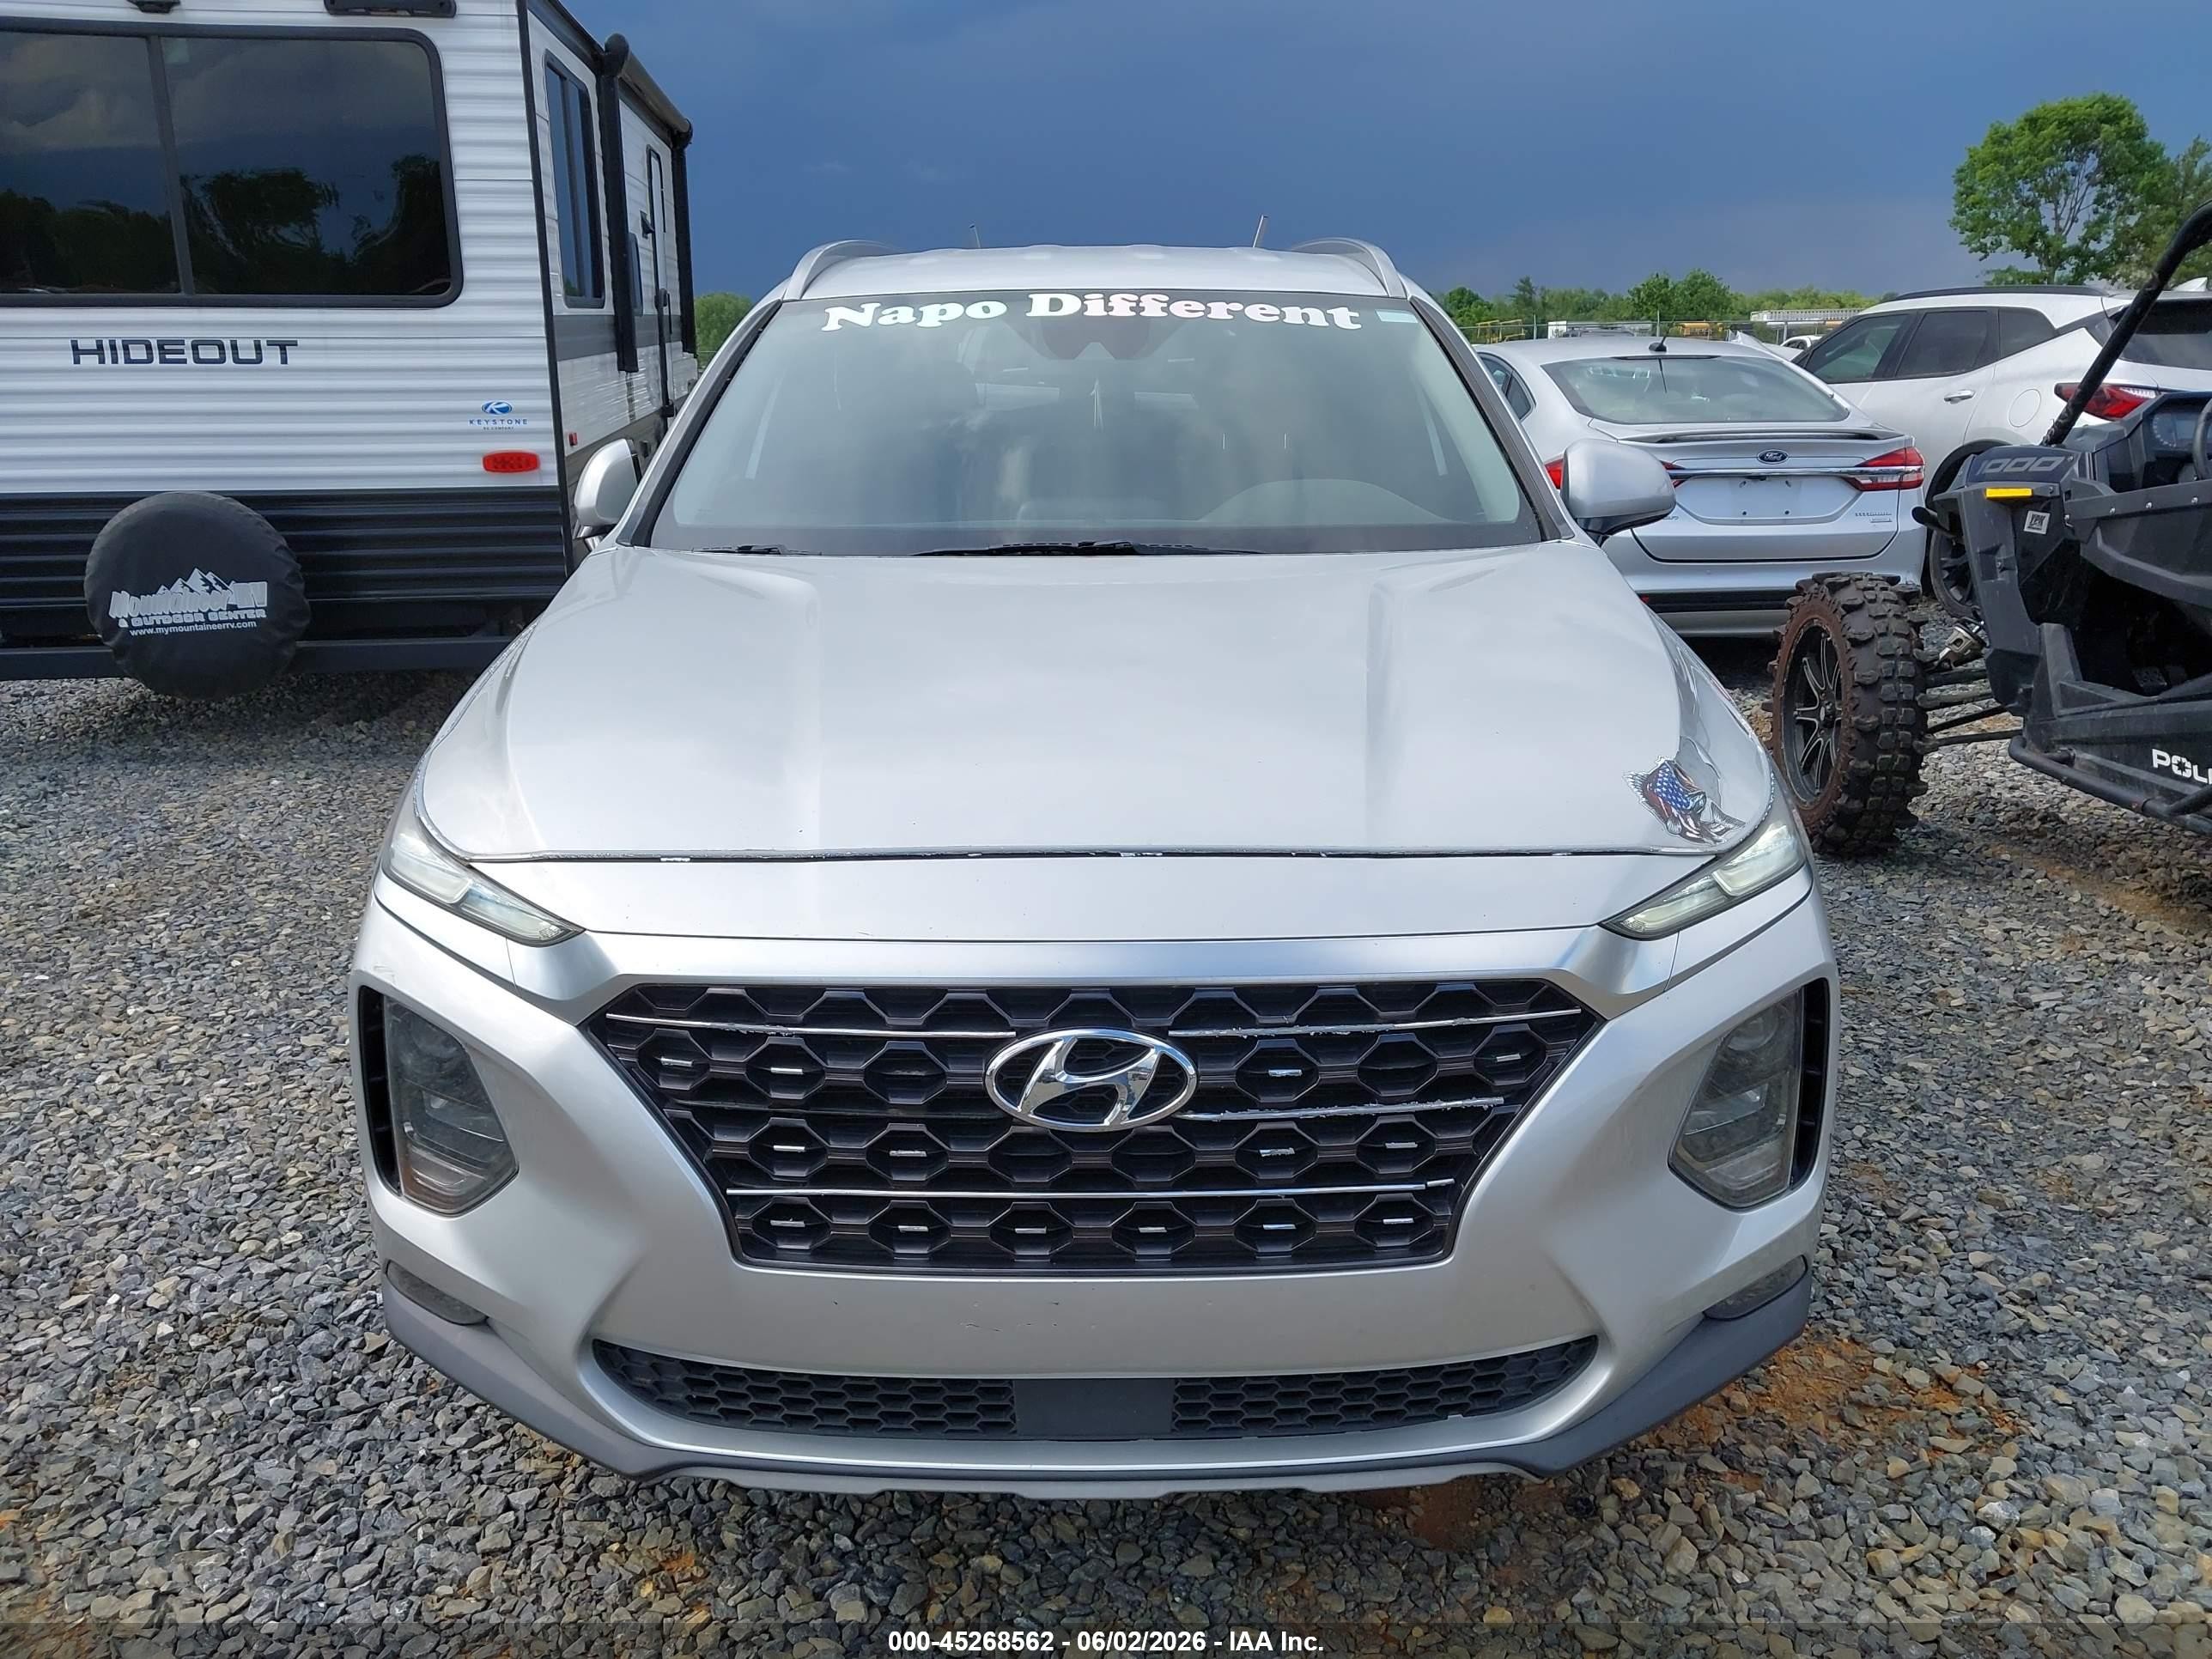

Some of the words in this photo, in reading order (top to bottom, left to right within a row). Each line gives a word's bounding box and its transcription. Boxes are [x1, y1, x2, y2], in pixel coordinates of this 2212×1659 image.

[821, 301, 1007, 331] Napo
[1025, 292, 1363, 330] Different
[70, 339, 299, 365] HIDEOUT
[130, 620, 258, 636] www.mymountaineerrv.com
[131, 612, 205, 627] OUTDOOR
[209, 609, 267, 621] CENTER
[2152, 748, 2212, 785] POL
